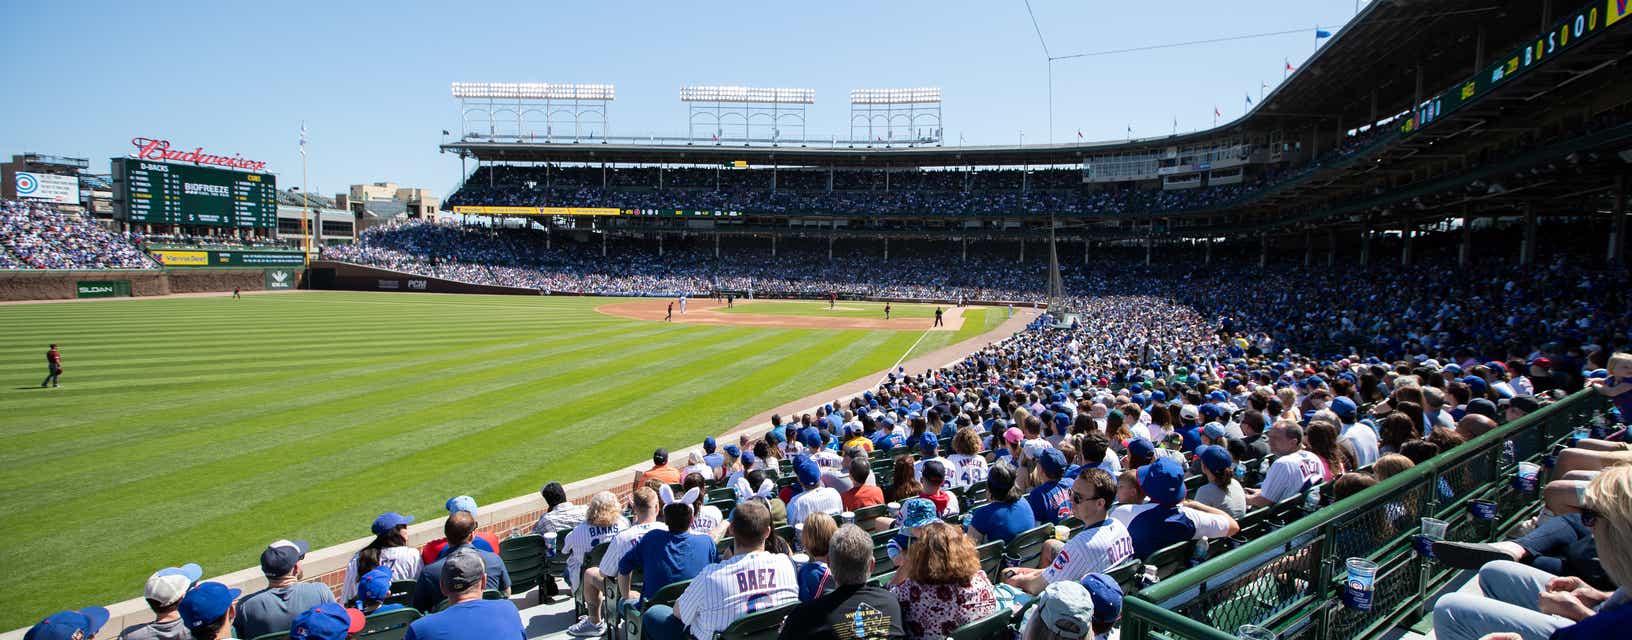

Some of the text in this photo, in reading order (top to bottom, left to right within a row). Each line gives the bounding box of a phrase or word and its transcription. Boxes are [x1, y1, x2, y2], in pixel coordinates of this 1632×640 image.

[1547, 31, 1556, 53] S
[132, 137, 266, 169] Budweiser
[184, 183, 230, 194] BIOFREEZE
[408, 280, 428, 290] PCM
[589, 523, 620, 537] BANKS
[1107, 536, 1133, 564] RIZZO
[736, 568, 777, 593] BAEZ
